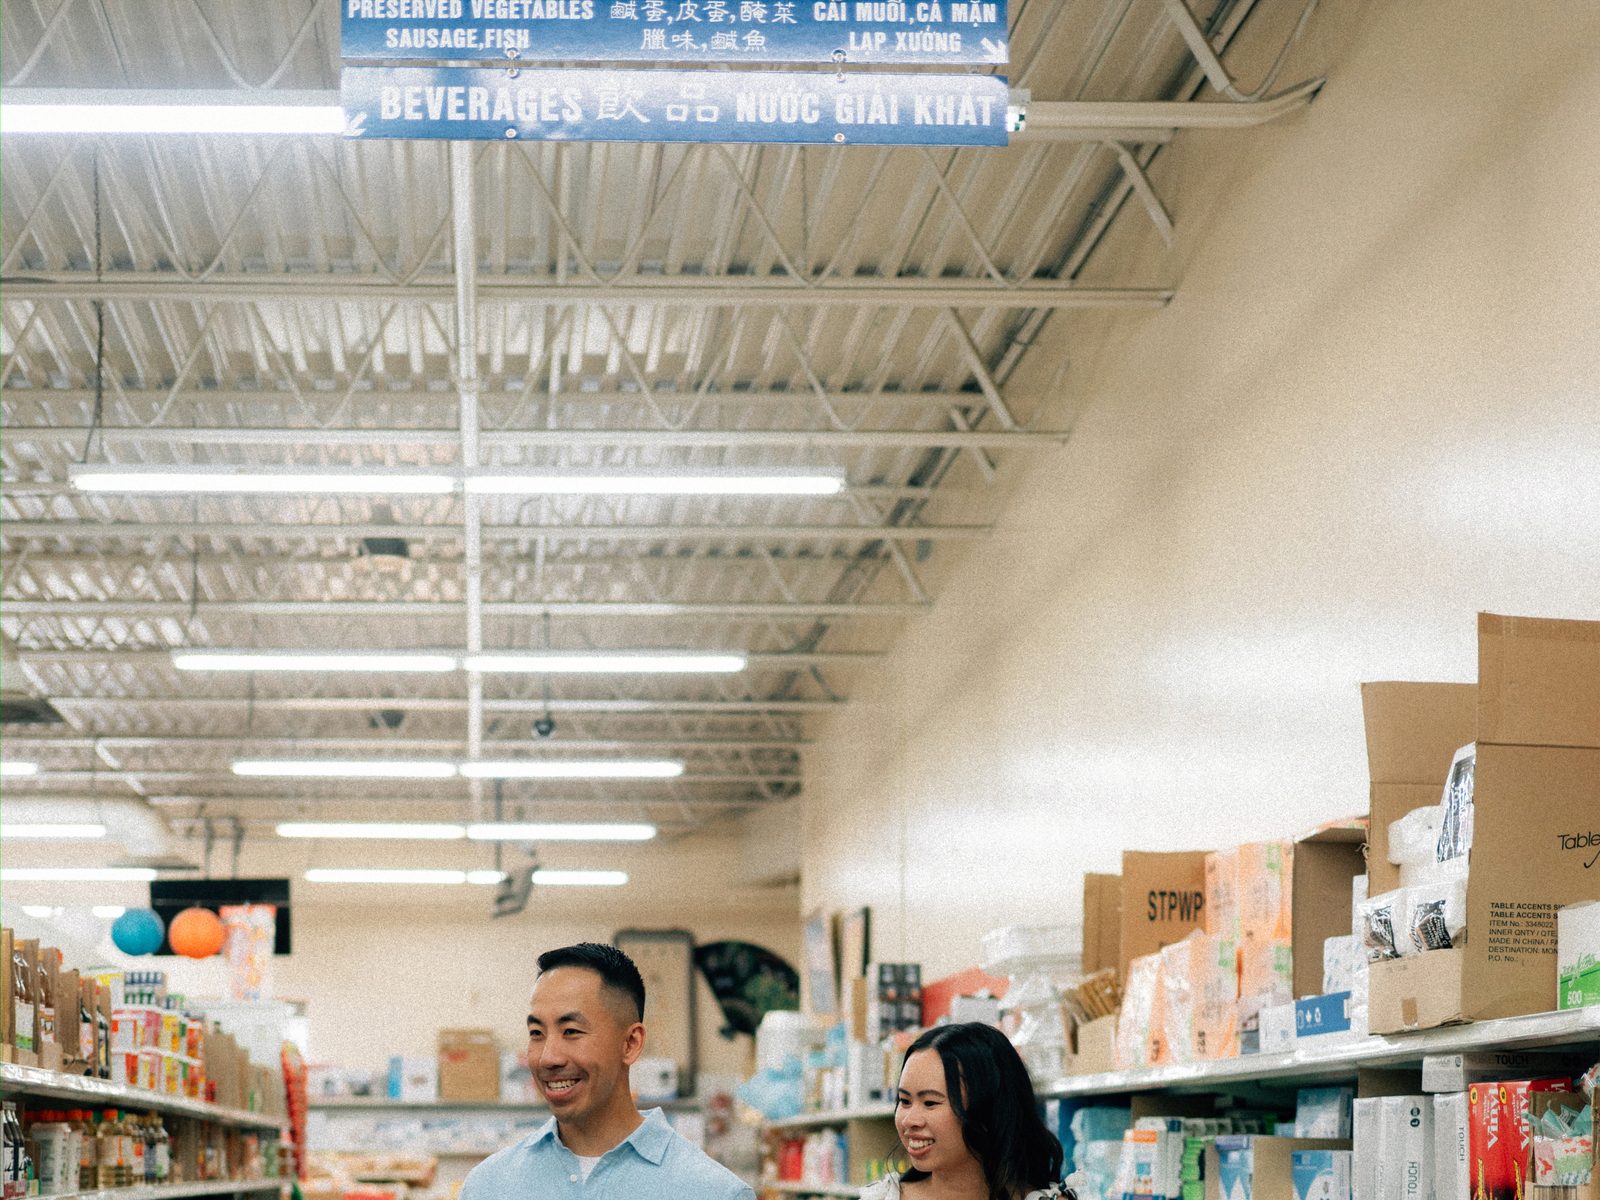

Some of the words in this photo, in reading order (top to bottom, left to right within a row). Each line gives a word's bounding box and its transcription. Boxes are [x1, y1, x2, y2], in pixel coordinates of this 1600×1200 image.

[347, 0, 462, 19] PRESERVED
[471, 0, 594, 20] VEGETABLES
[386, 28, 531, 51] SAUSAGE,FISH
[380, 86, 583, 122] BEVERAGES
[1557, 831, 1600, 850] Table
[1490, 902, 1515, 910] TABLE
[1487, 1087, 1501, 1150] Vinyl
